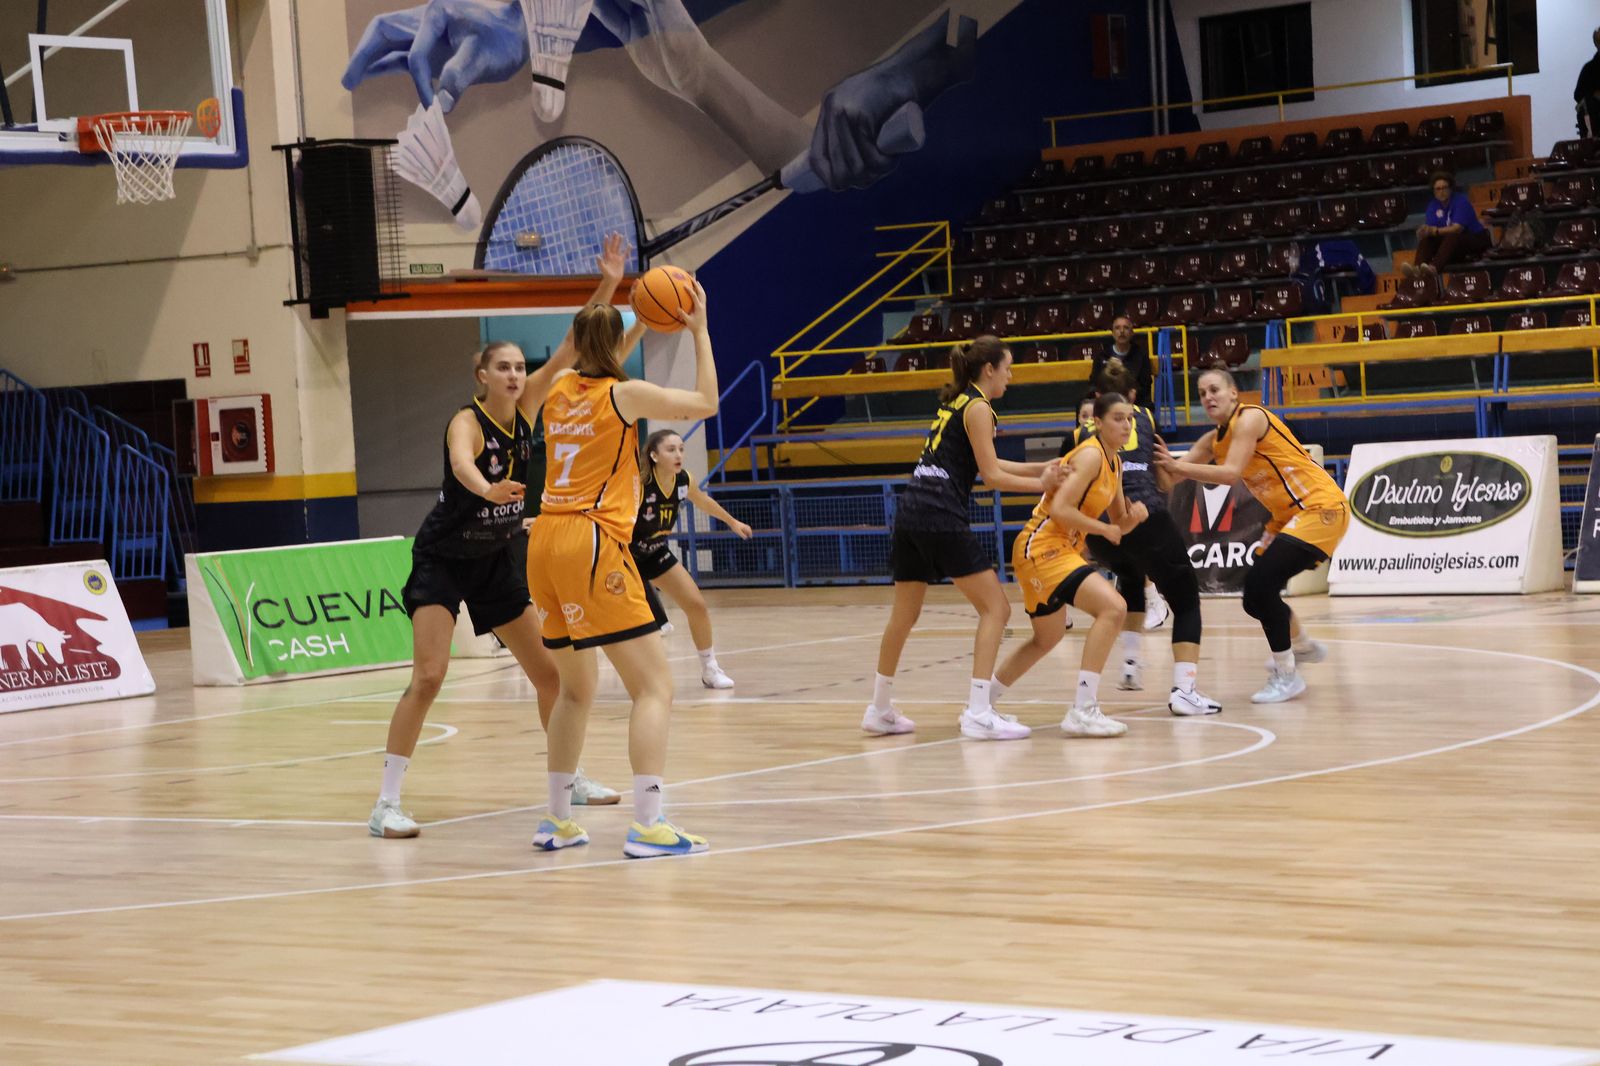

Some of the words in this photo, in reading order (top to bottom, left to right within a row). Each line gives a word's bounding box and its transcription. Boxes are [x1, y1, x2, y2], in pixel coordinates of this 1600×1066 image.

[554, 443, 580, 488] 7
[1365, 474, 1443, 514] Paulino
[1450, 471, 1522, 513] Iglesias
[1389, 515, 1434, 526] Embutidos
[1434, 517, 1442, 527] y
[1442, 514, 1482, 525] Jamones
[1338, 551, 1520, 575] www.paulinoiglesias.com
[268, 632, 350, 661] CASH
[55, 661, 112, 683] ALISTE
[661, 993, 923, 1022] PLATA
